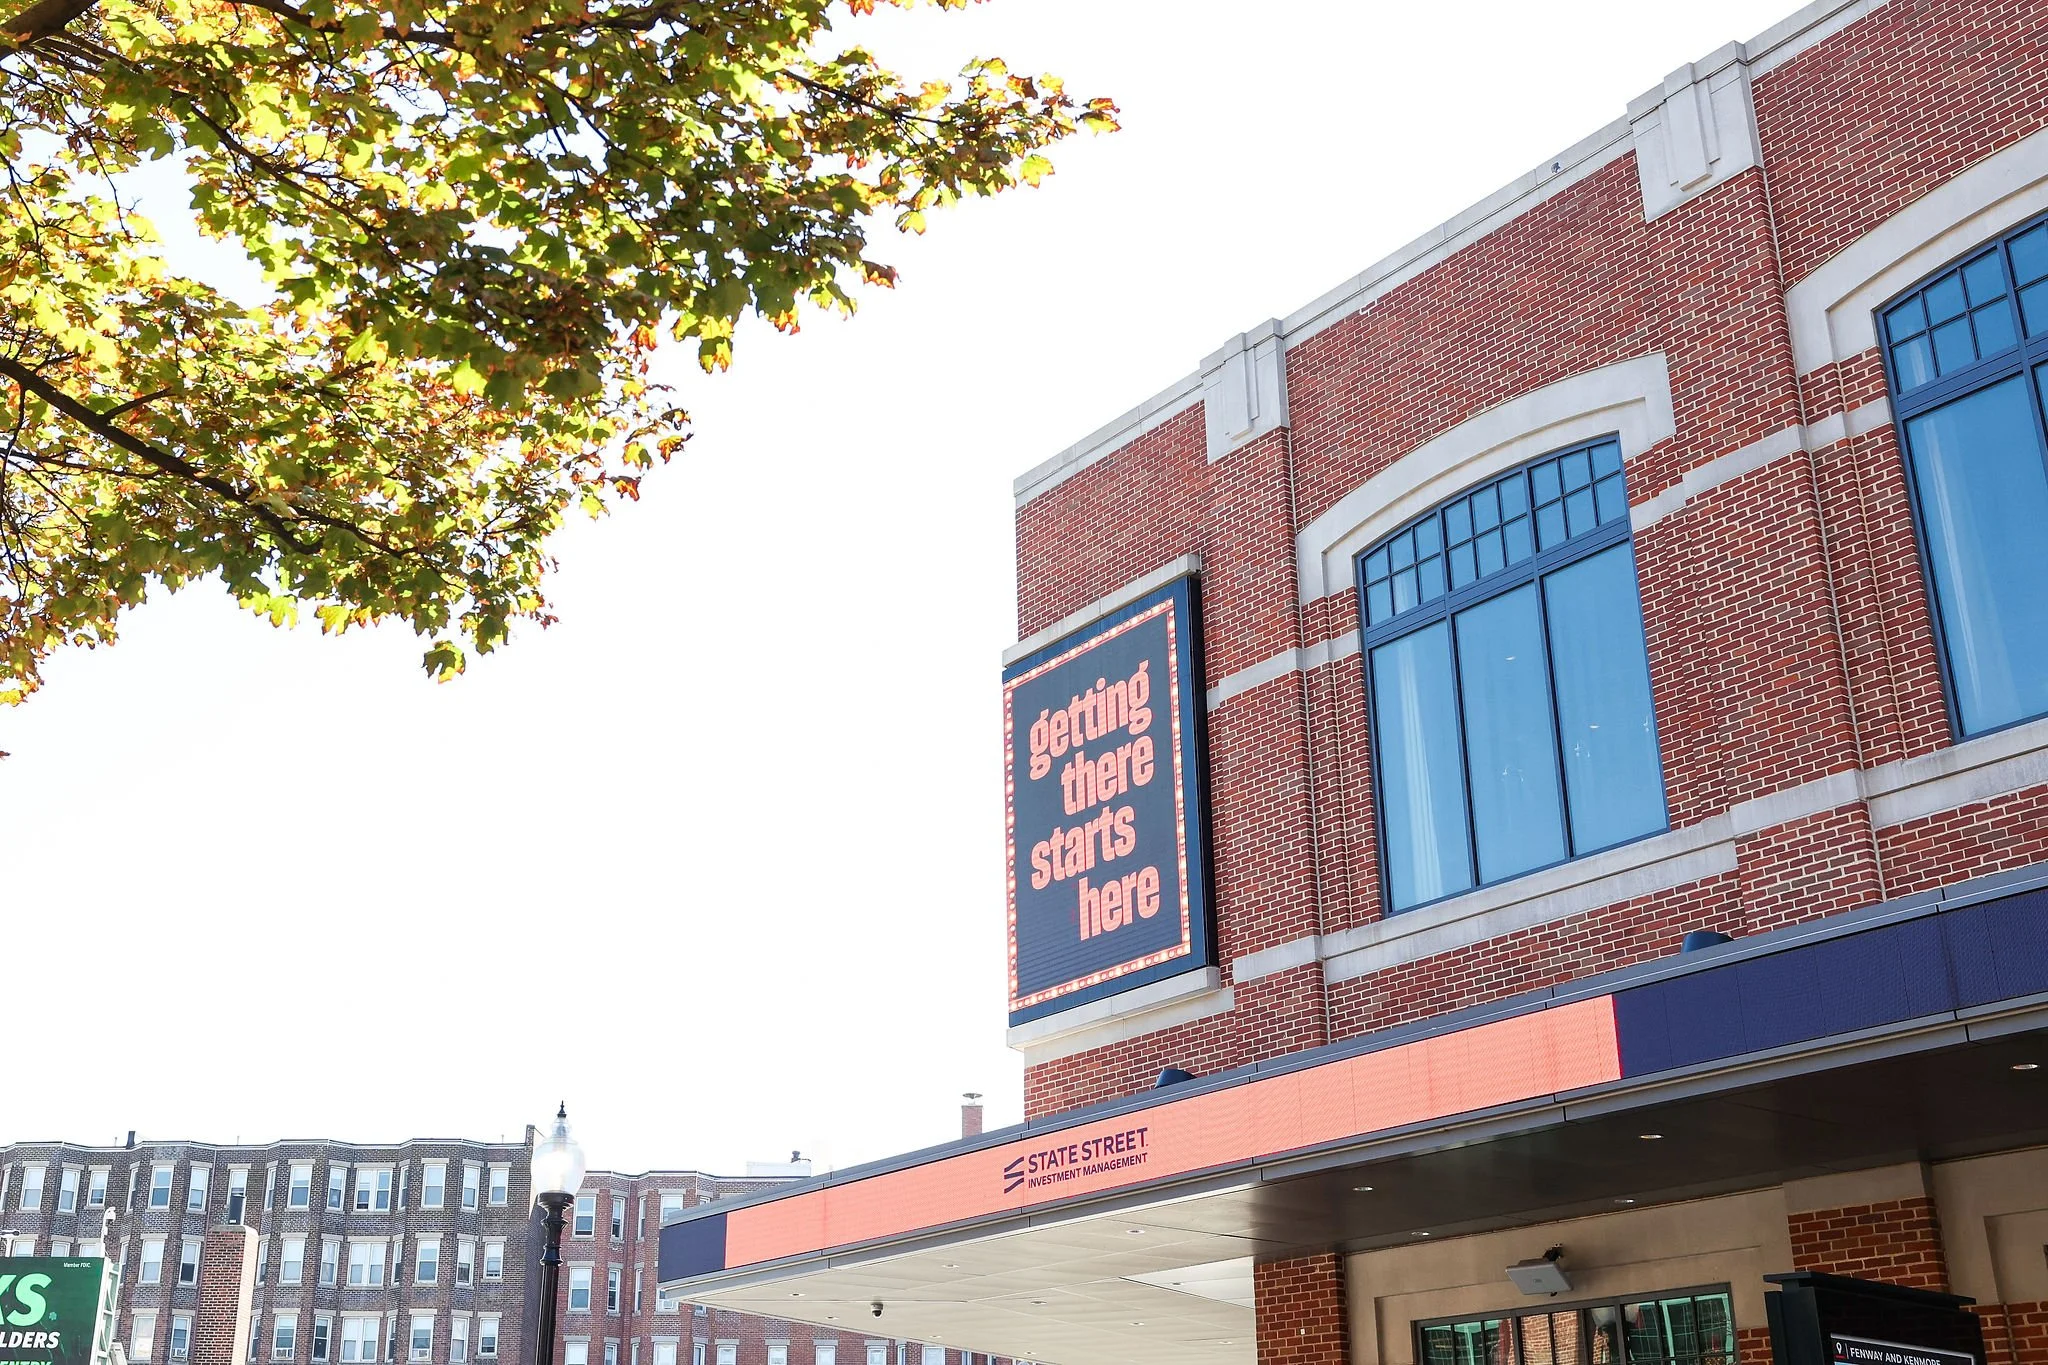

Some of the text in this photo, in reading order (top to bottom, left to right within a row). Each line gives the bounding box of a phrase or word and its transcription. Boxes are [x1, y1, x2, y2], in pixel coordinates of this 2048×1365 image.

[1028, 659, 1153, 781] getting
[1061, 735, 1155, 817] there
[1030, 803, 1137, 892] starts
[1078, 865, 1161, 942] here
[1028, 1144, 1078, 1174] STATE
[1028, 1152, 1148, 1189] INVESTMENT MANAGEMENT
[1849, 1347, 1884, 1361] FENWAY
[1885, 1352, 1903, 1364] AND
